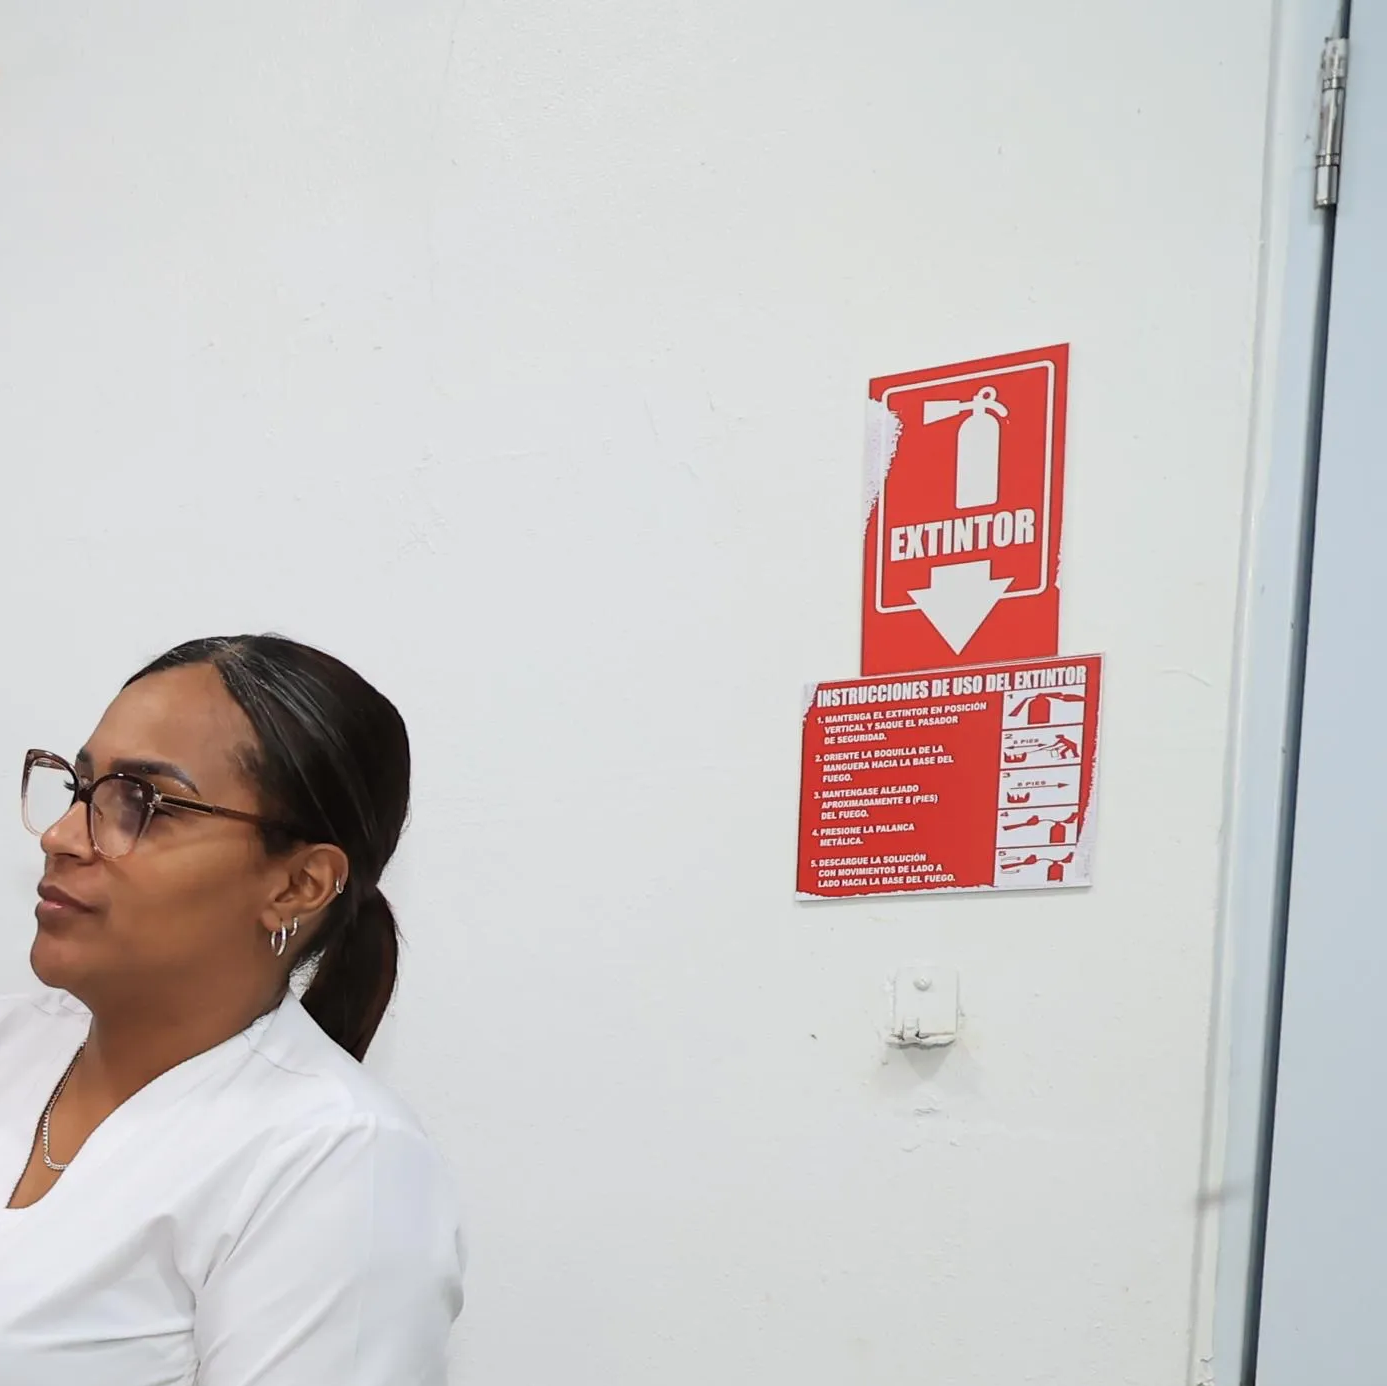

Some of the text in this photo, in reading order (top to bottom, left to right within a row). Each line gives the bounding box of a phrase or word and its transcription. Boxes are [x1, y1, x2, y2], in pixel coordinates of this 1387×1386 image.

[890, 508, 1035, 561] EXTINTOR
[817, 665, 1086, 707] INSTRUCCIONES DE USO DEL EXTINTOR
[817, 702, 987, 724] 1. MANTENGA EL EXTINTOR EN POSICIÓN
[824, 716, 958, 735] VERTICAL Y SAQUE EL PASADOR
[824, 733, 887, 745] DE SEGURIDAD.
[824, 751, 859, 762] ORIENTE
[862, 750, 872, 759] LA
[874, 747, 916, 759] BOQUILLA
[919, 746, 930, 754] DE
[932, 745, 944, 753] LA
[823, 755, 954, 772] MANGUERA HACIA LA BASE DEL
[823, 774, 852, 783] FUEGO.
[822, 788, 879, 798] MANTENGASE
[880, 785, 919, 795] ALEJADO
[821, 794, 938, 809] APROXIMADAMENTE 8 (PIES)
[821, 810, 869, 820] DEL FUEGO.
[821, 826, 861, 836] PRESIONE
[863, 825, 874, 834] LA
[876, 823, 915, 833] PALANCA
[820, 836, 863, 847] METÁLICA.
[819, 857, 868, 867] DESCARGUE
[870, 856, 882, 864] LA
[883, 853, 926, 863] SOLUCIÓN
[819, 869, 836, 877] CON
[838, 866, 896, 876] MOVIMIENTOS
[898, 865, 909, 873] DE
[818, 874, 955, 888] LADO HACIA LA BASE DEL FUEGO.
